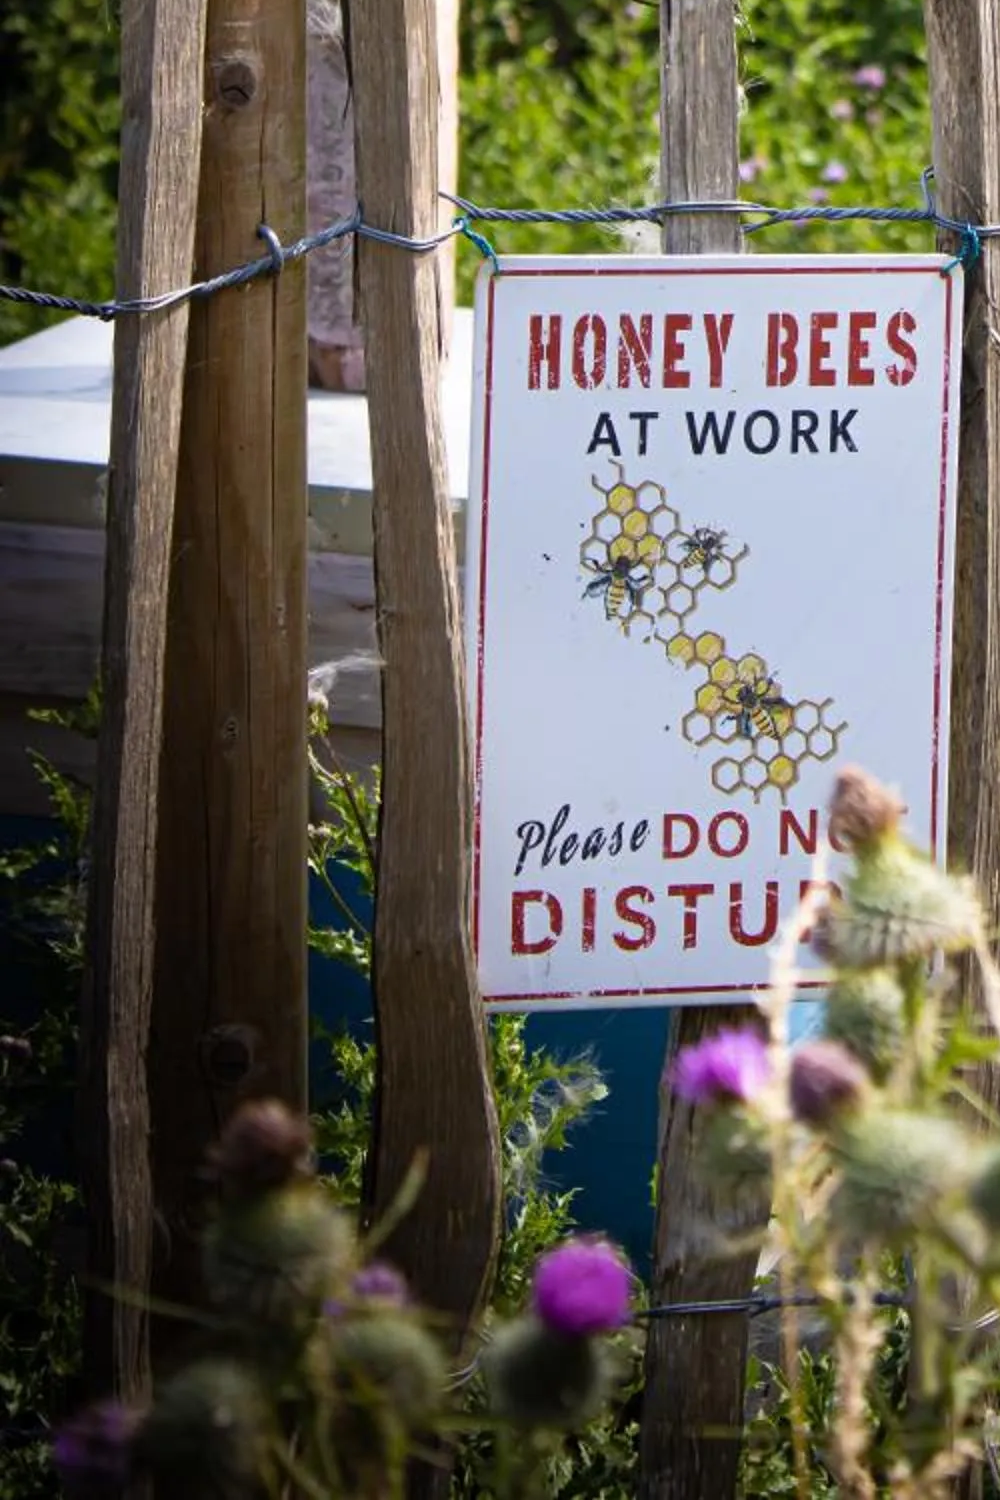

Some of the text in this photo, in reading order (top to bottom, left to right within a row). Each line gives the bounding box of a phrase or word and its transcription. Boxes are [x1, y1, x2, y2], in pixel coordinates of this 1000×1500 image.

[527, 310, 917, 390] HONEY BEES
[586, 408, 859, 456] AT WORK
[513, 803, 650, 877] Please
[662, 809, 750, 859] DO
[511, 879, 842, 956] DISTU
